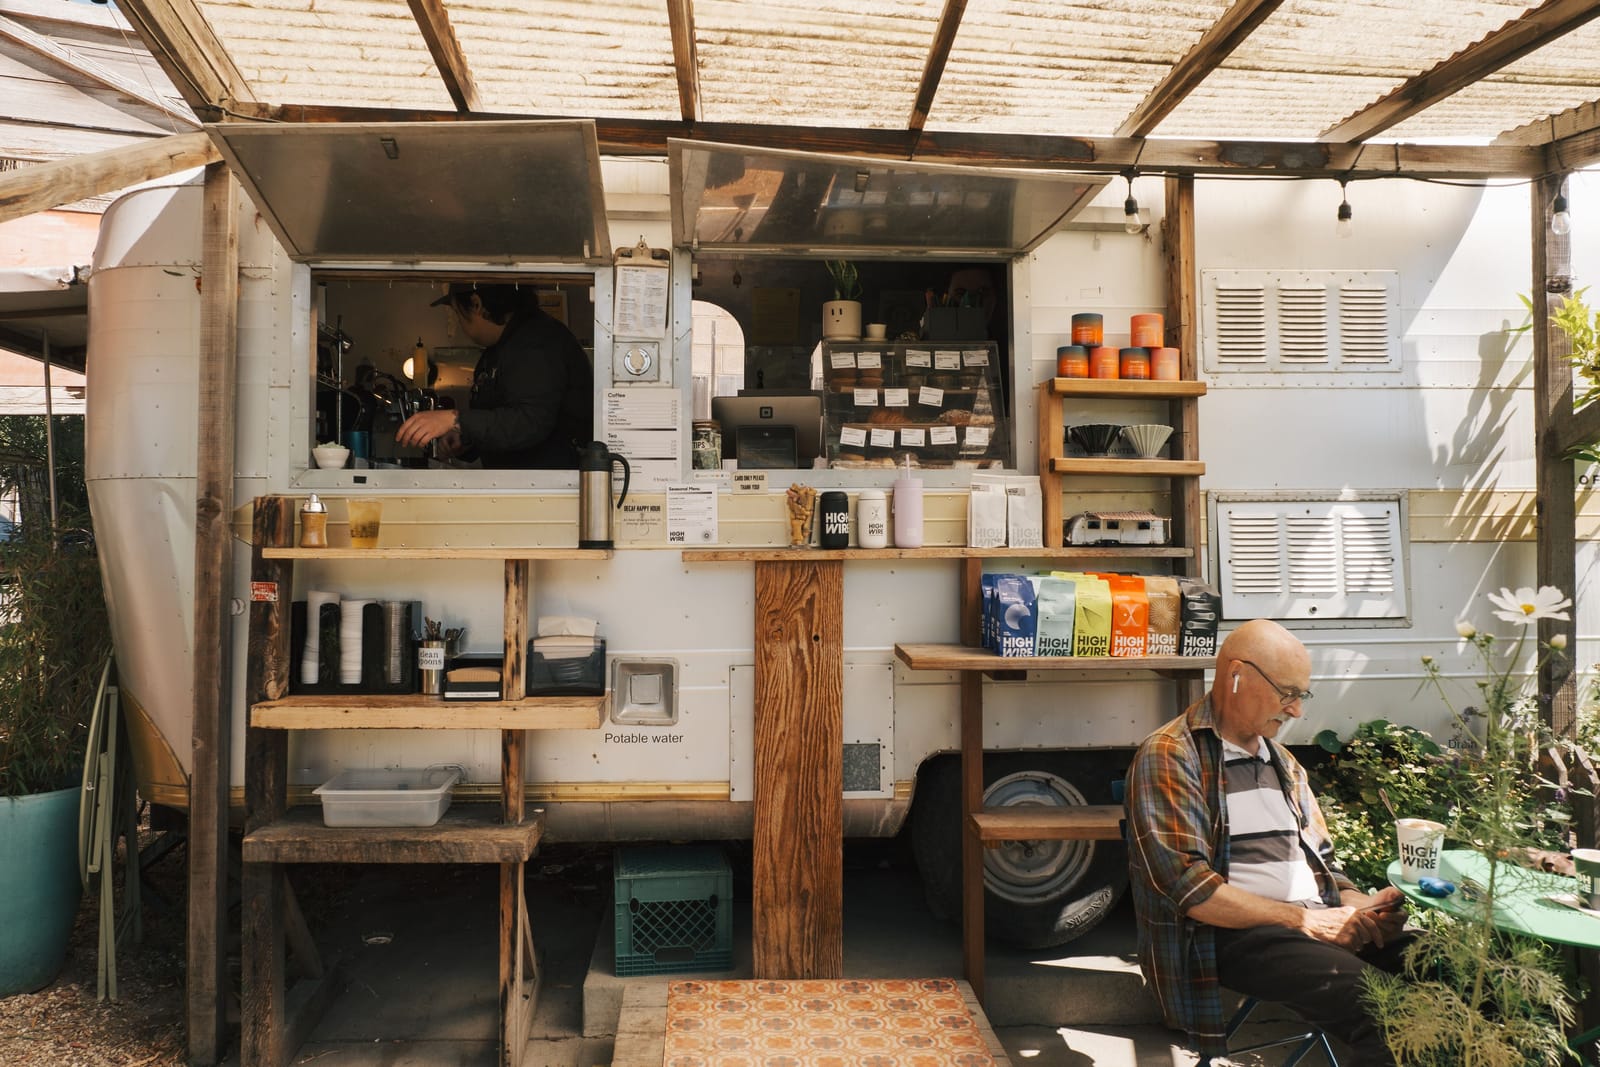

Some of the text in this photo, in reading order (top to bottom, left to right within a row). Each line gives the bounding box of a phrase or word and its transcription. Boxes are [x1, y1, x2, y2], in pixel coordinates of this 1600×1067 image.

[975, 528, 1002, 538] HIGH
[1012, 528, 1040, 538] HIGH
[1012, 538, 1040, 547] WIRE
[1003, 637, 1033, 648] HIGH
[1039, 637, 1069, 648] HIGH
[1077, 636, 1107, 646] HIGH
[1114, 636, 1144, 647] HIGH
[1147, 633, 1176, 644] HIGH
[1184, 636, 1214, 647] HIGH
[1003, 648, 1033, 657] WIRE
[1038, 648, 1069, 656] WIRE
[1077, 646, 1106, 656] WIRE
[1113, 647, 1144, 657] WIRE
[1147, 645, 1176, 655] WIRE
[1182, 647, 1214, 656] WIRE
[604, 733, 684, 743] Potable water
[1401, 843, 1438, 857] HIGH
[1402, 854, 1436, 870] WIRE
